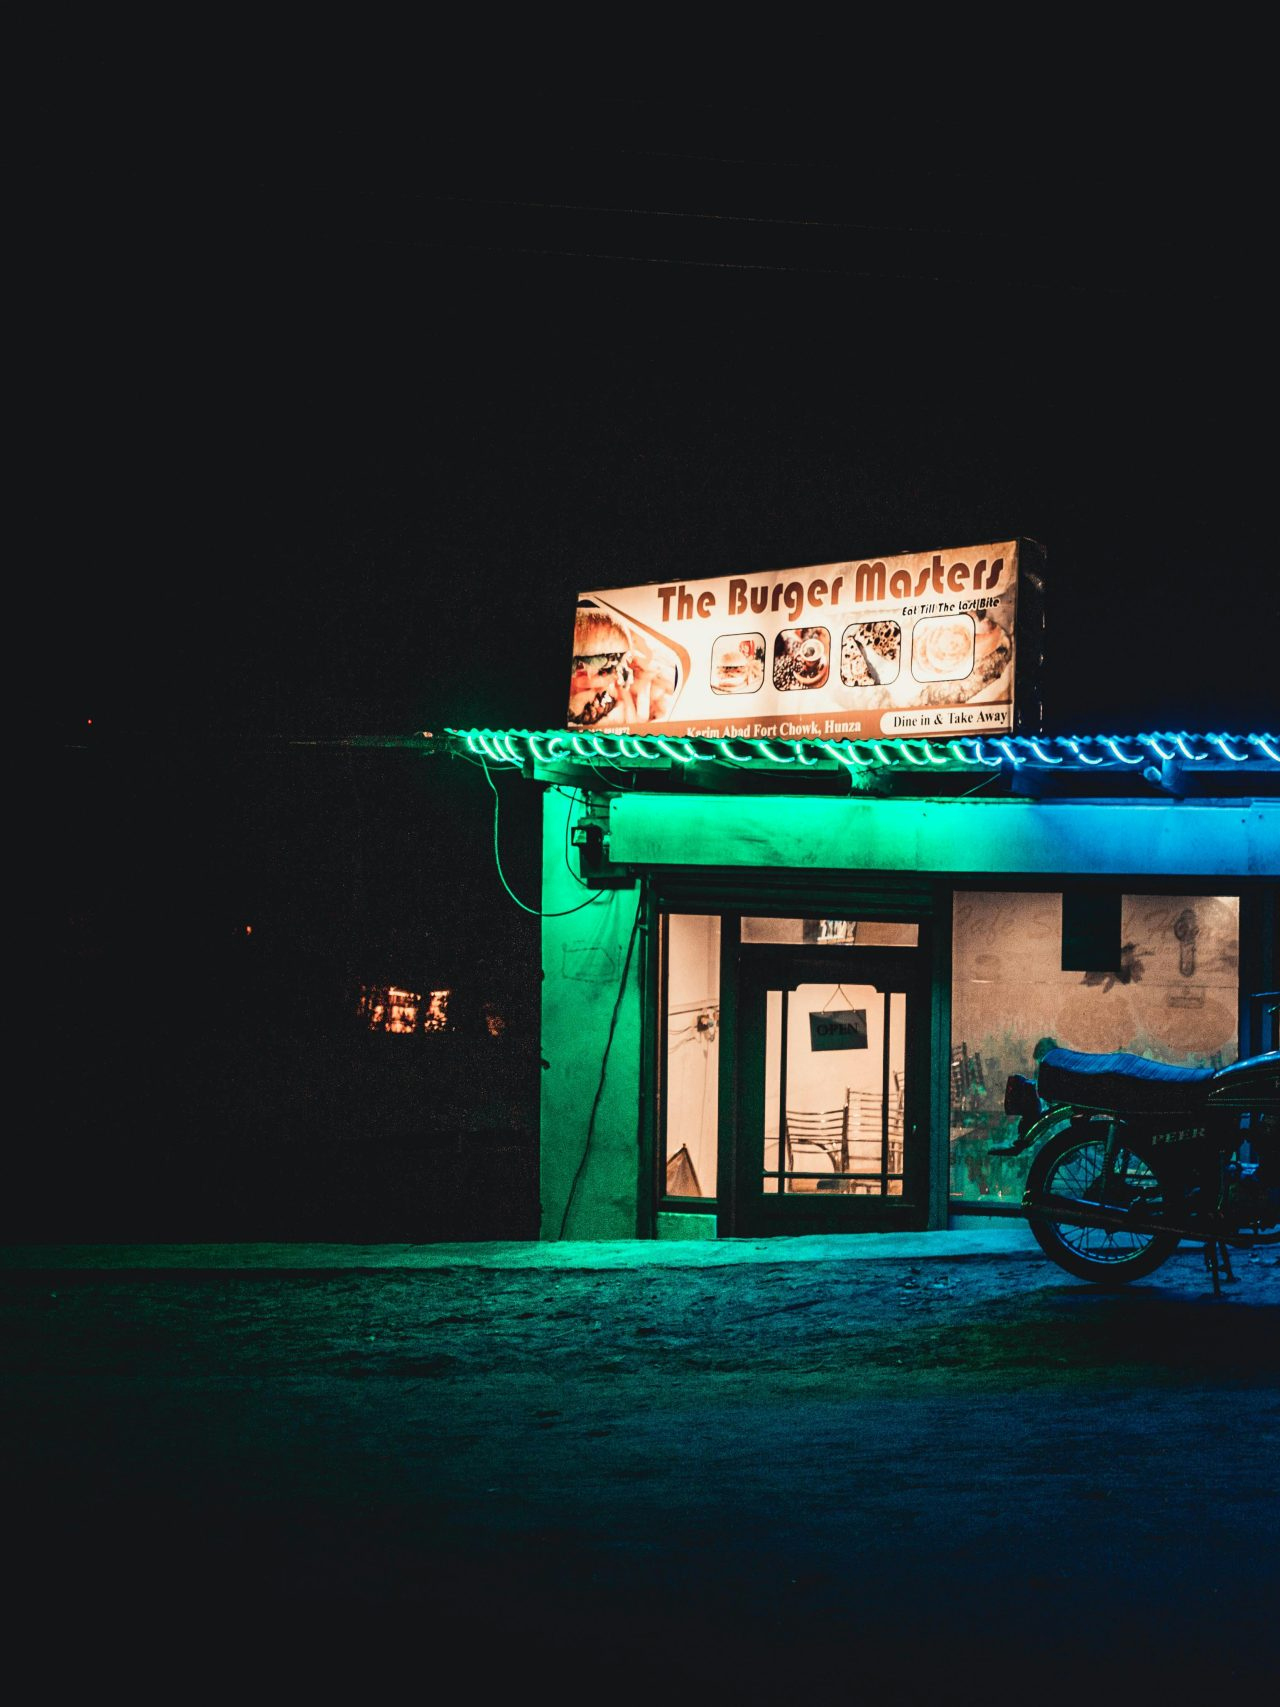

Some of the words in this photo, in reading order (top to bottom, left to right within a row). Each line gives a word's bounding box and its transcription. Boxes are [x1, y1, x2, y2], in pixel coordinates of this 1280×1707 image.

[657, 585, 716, 622] The
[728, 576, 844, 622] Burger
[855, 554, 1004, 603] Masters
[902, 606, 917, 616] Eat
[920, 603, 935, 614] Till
[938, 602, 955, 613] The
[980, 597, 1000, 609] Bite
[723, 725, 751, 738] Abad
[753, 723, 777, 737] Fort
[779, 721, 822, 737] Chowk,
[825, 719, 862, 734] Hunza
[893, 715, 918, 728] Dine
[920, 714, 931, 726] in
[933, 713, 943, 725] &
[948, 711, 974, 725] Take
[976, 710, 1008, 725] Away
[816, 1022, 859, 1036] OPEN
